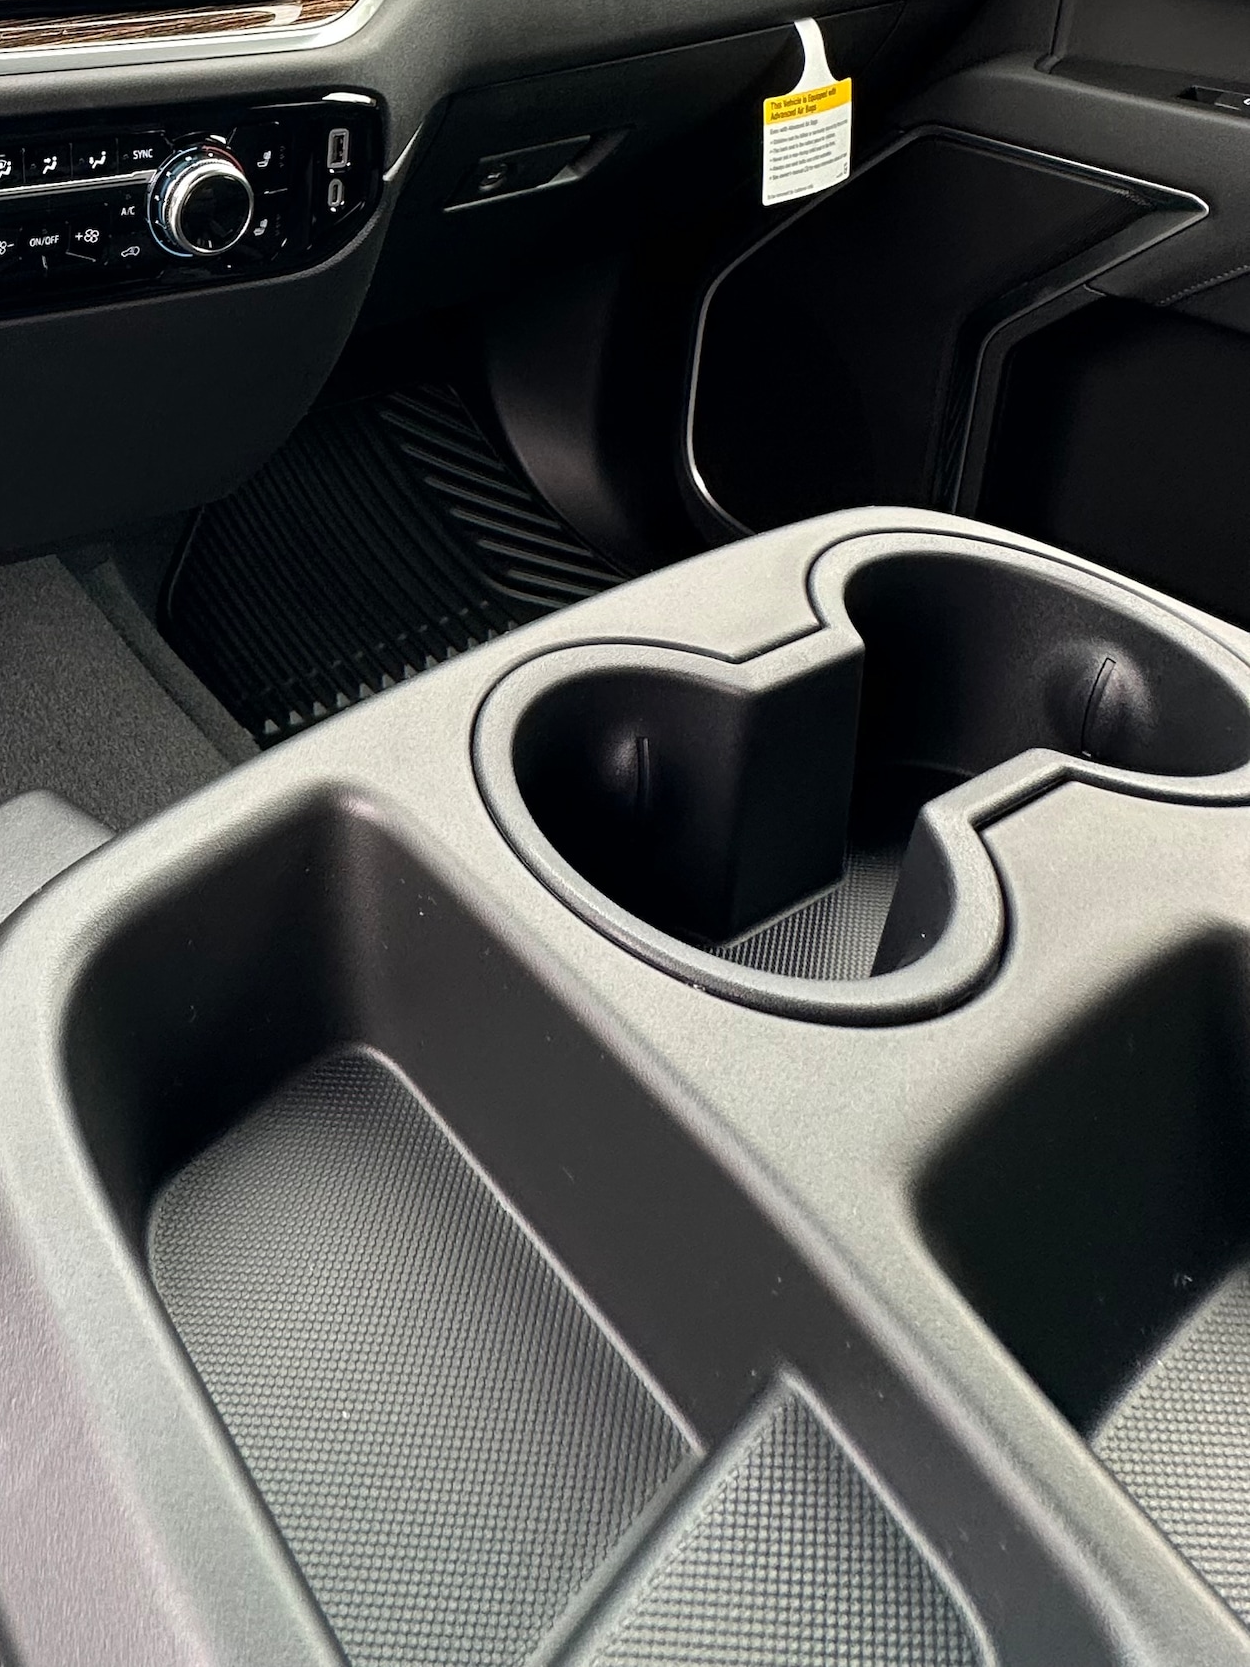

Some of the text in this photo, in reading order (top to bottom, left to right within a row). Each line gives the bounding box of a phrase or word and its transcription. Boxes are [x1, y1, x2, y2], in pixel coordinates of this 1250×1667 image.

[133, 148, 154, 160] SYNC
[121, 206, 136, 216] A/C
[29, 234, 60, 247] ON/OFF
